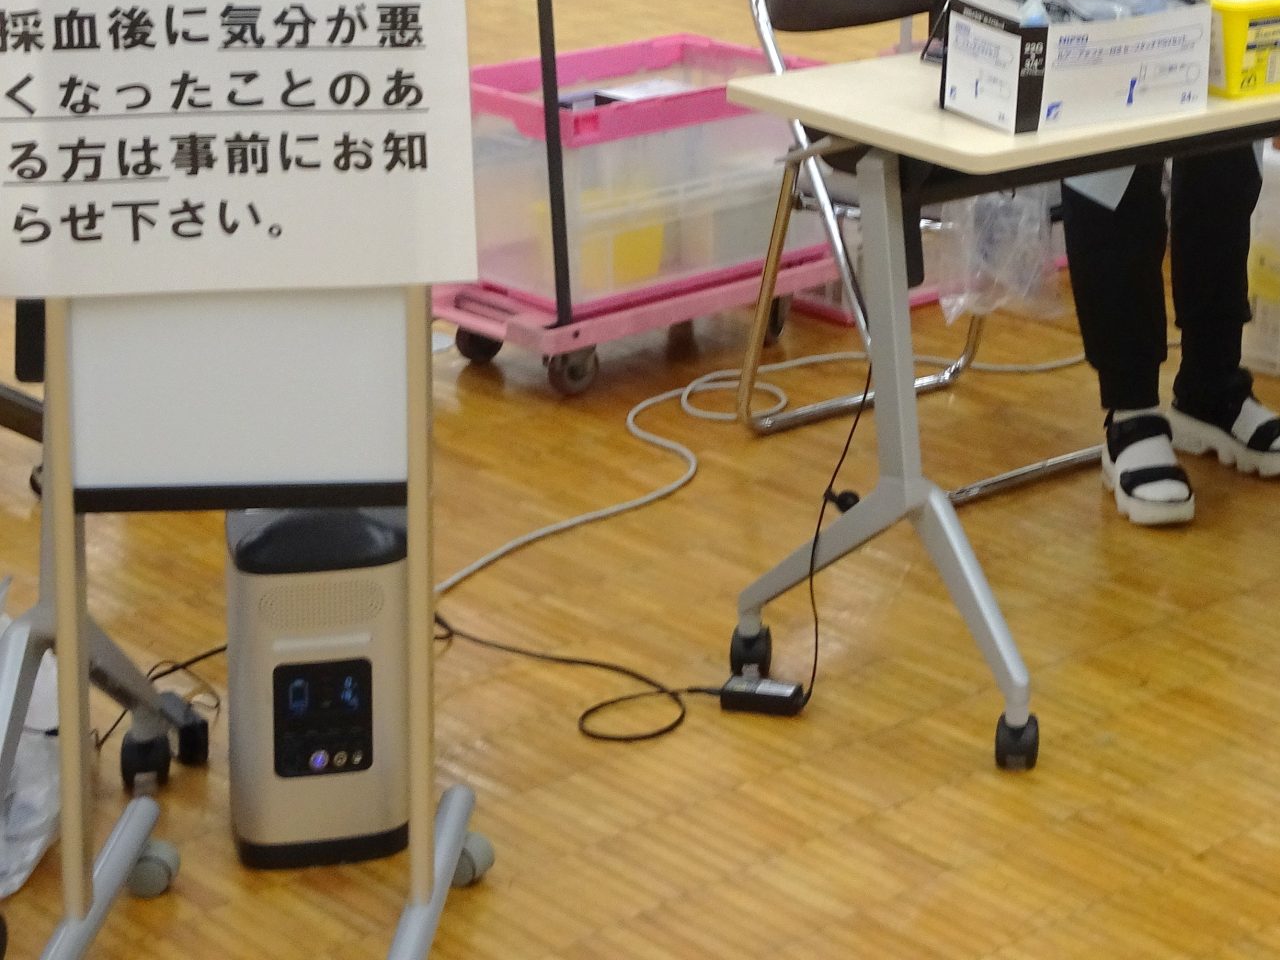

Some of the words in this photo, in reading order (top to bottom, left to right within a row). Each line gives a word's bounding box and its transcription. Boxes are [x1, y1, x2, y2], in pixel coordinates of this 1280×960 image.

[0, 3, 424, 52] 採血後に気分が悪
[4, 68, 424, 114] くなったことのあ
[8, 131, 429, 182] る方は事前にお知
[13, 199, 283, 245] らせ下さい。
